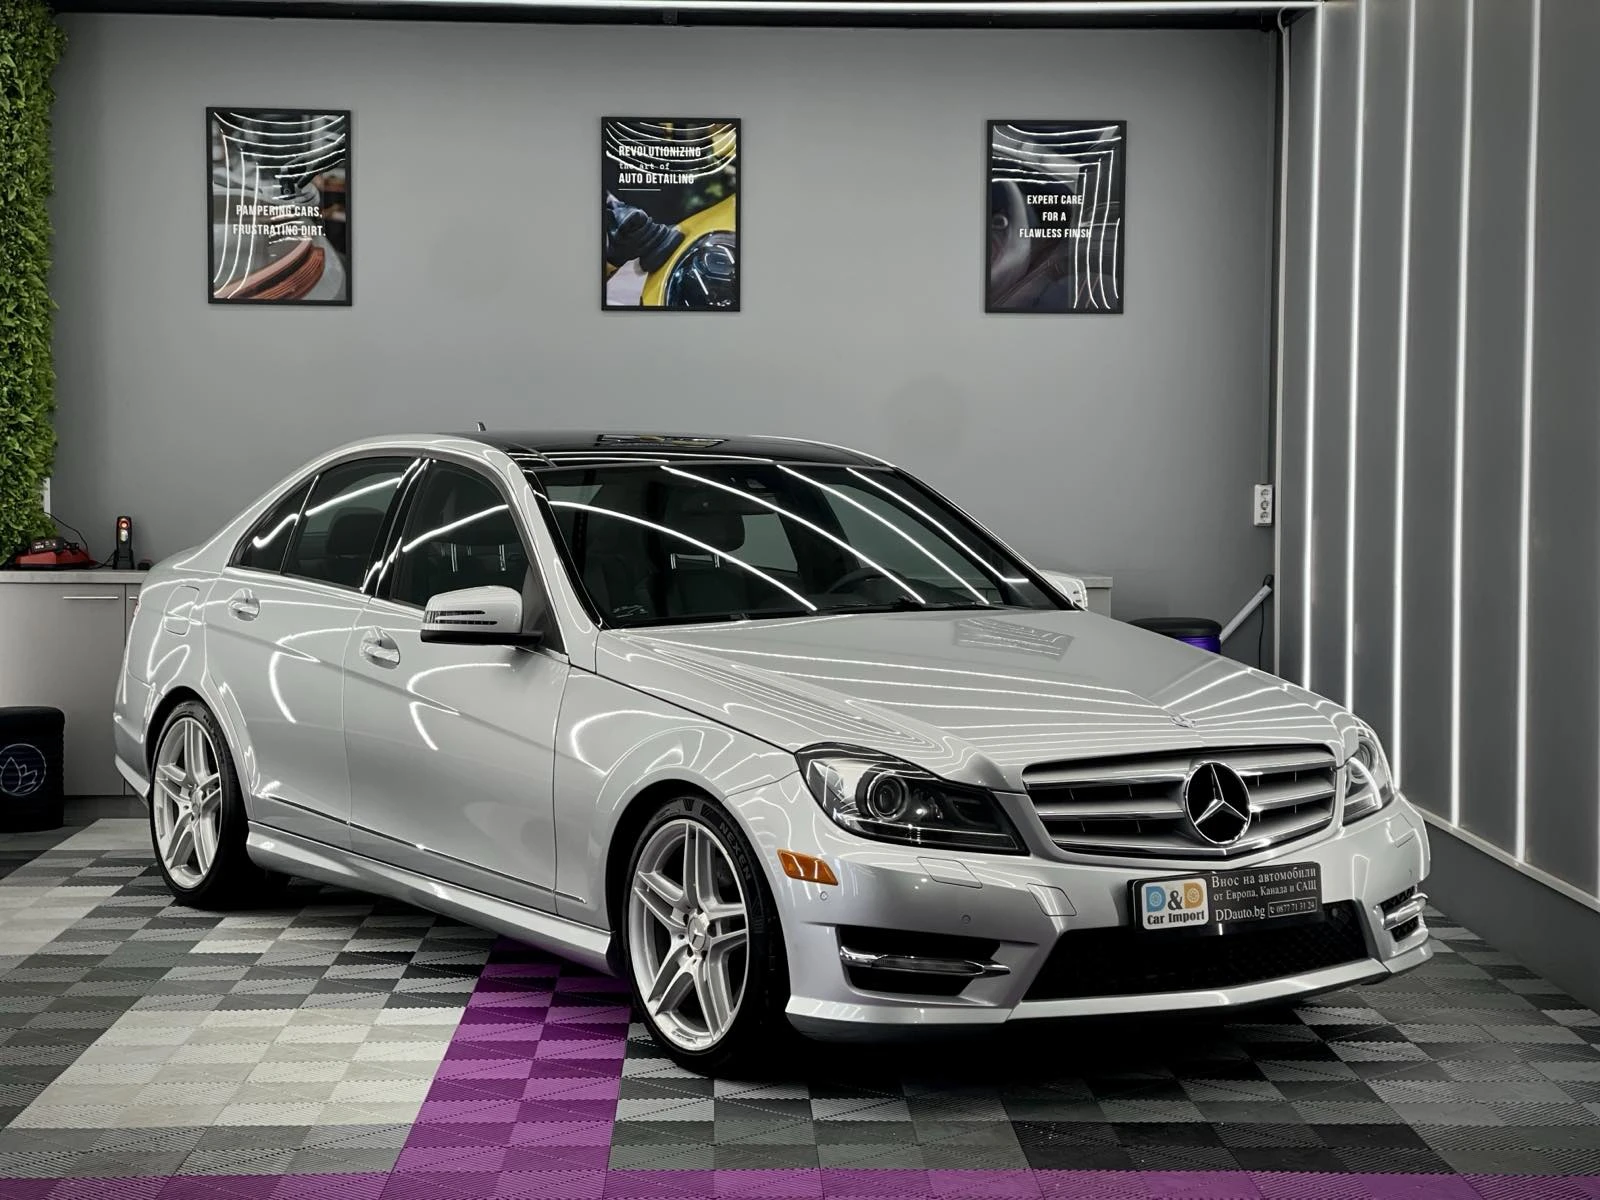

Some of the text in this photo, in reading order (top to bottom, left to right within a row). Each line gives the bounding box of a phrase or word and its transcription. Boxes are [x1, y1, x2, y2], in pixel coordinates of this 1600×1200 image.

[618, 146, 701, 157] REVOLUTIONIZING
[659, 162, 670, 170] of
[618, 172, 695, 184] AUTO DETAILING
[1027, 195, 1083, 204] EXPERT CARE
[236, 204, 292, 216] PAMPERING
[1042, 212, 1066, 221] FOR A
[232, 223, 299, 235] FRUSTRATING
[1019, 228, 1092, 238] FLAWLESS FINISH
[719, 822, 751, 880] NEXEN
[1212, 867, 1317, 888] Внос на автомобили
[1213, 893, 1223, 901] от
[1260, 886, 1288, 896] Канада
[1296, 880, 1317, 891] САЩ
[1147, 910, 1205, 925] Car Import
[1215, 905, 1266, 921] DDauto.bg
